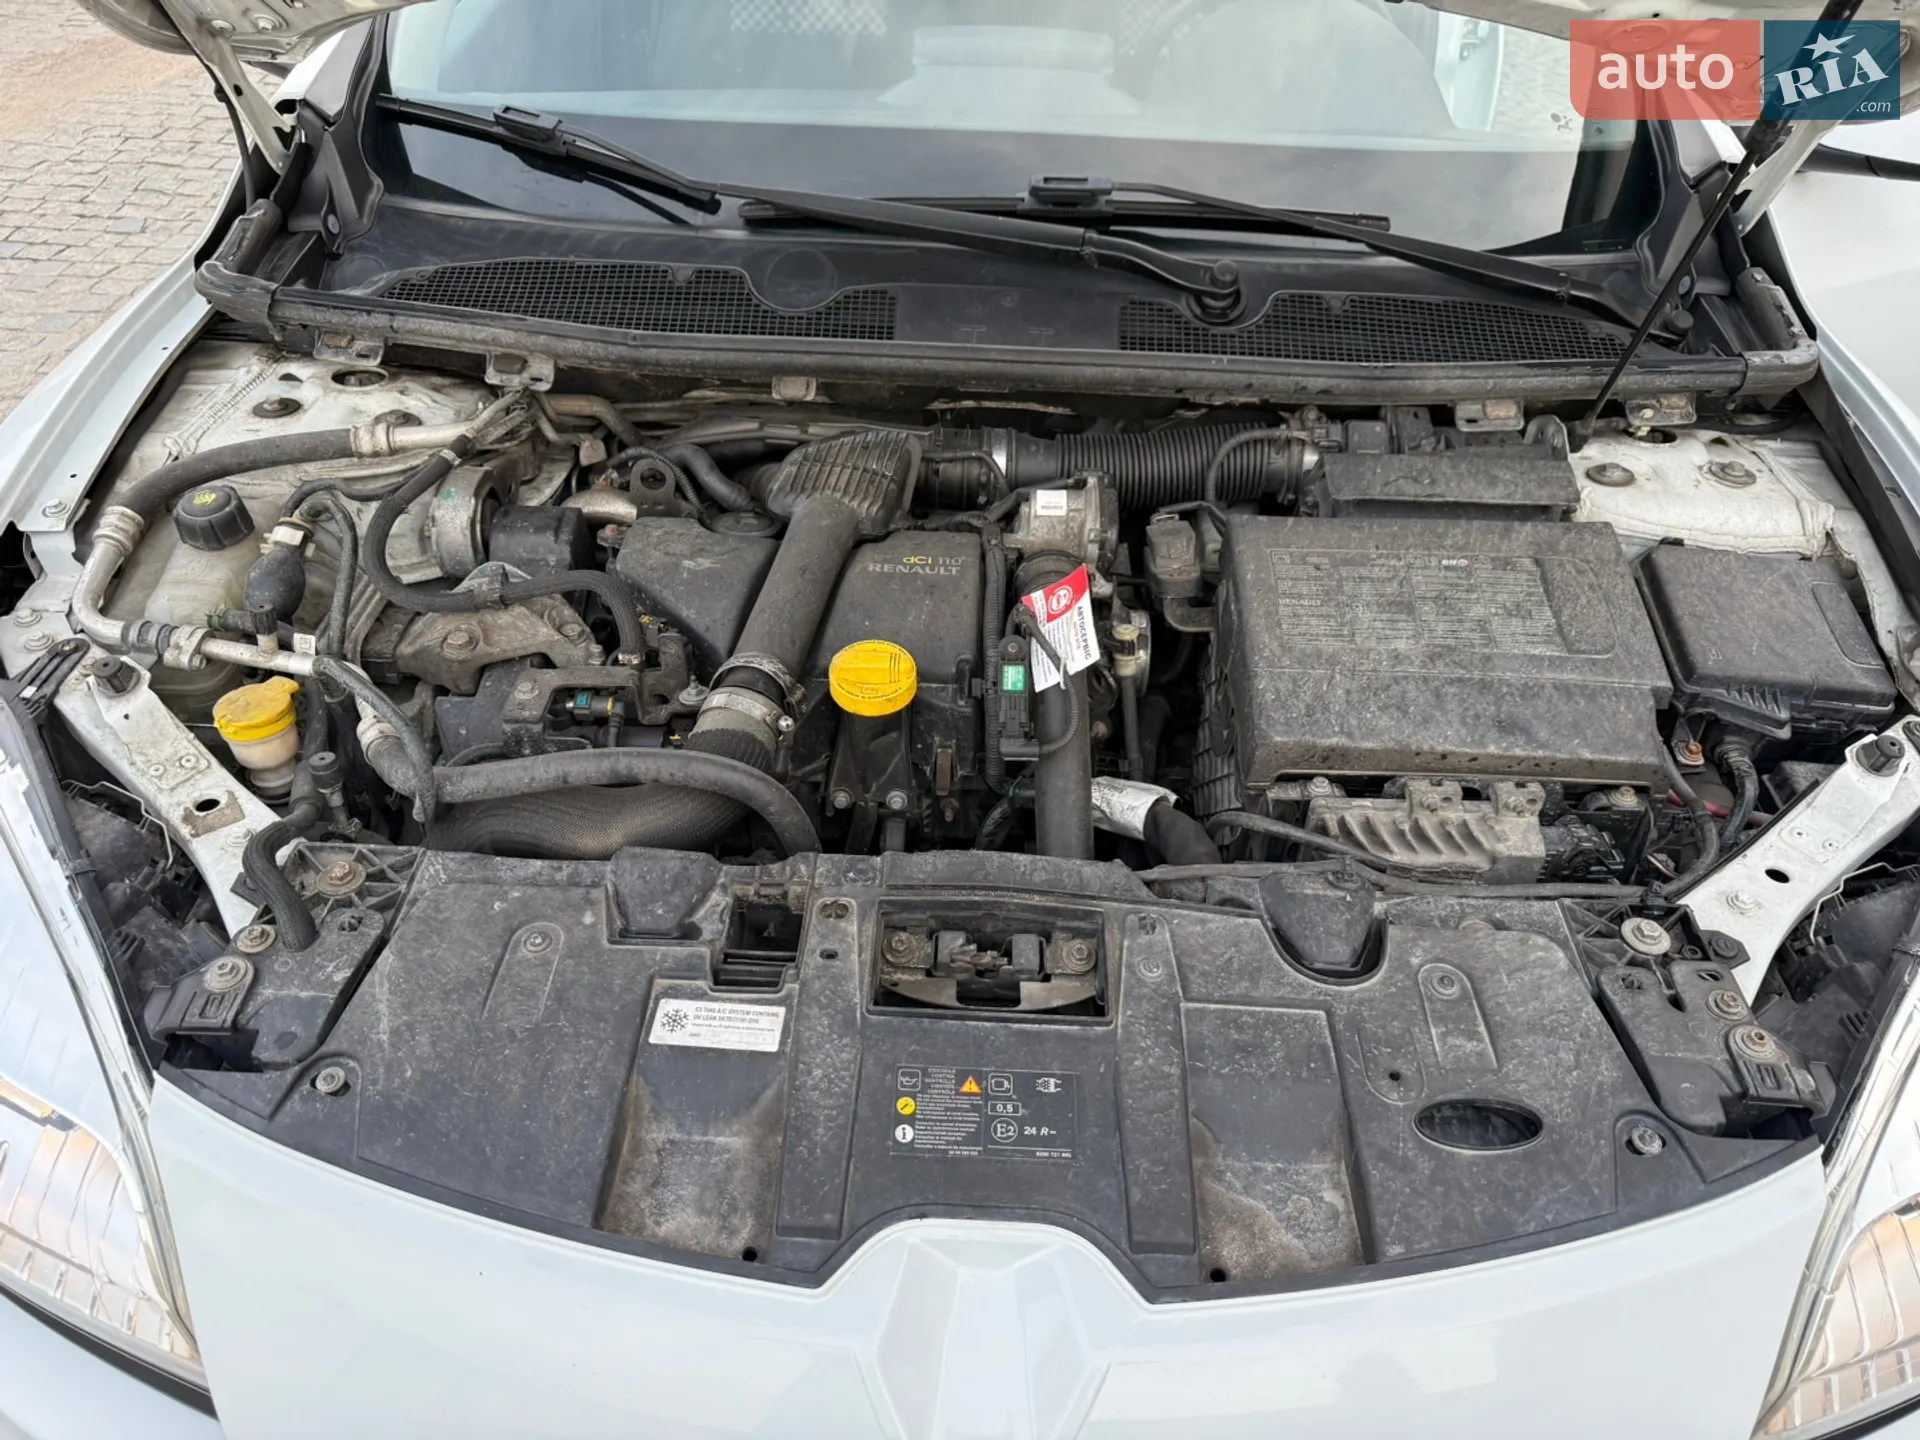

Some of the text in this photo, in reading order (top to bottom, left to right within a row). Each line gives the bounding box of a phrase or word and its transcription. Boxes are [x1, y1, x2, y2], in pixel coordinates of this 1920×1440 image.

[868, 564, 961, 575] RENAULT
[1278, 598, 1322, 606] RENAULT
[1076, 605, 1092, 660] АВТОСЕРВІС
[996, 1103, 1014, 1113] 0,5
[996, 1123, 1015, 1138] E2
[1023, 1126, 1037, 1136] 24
